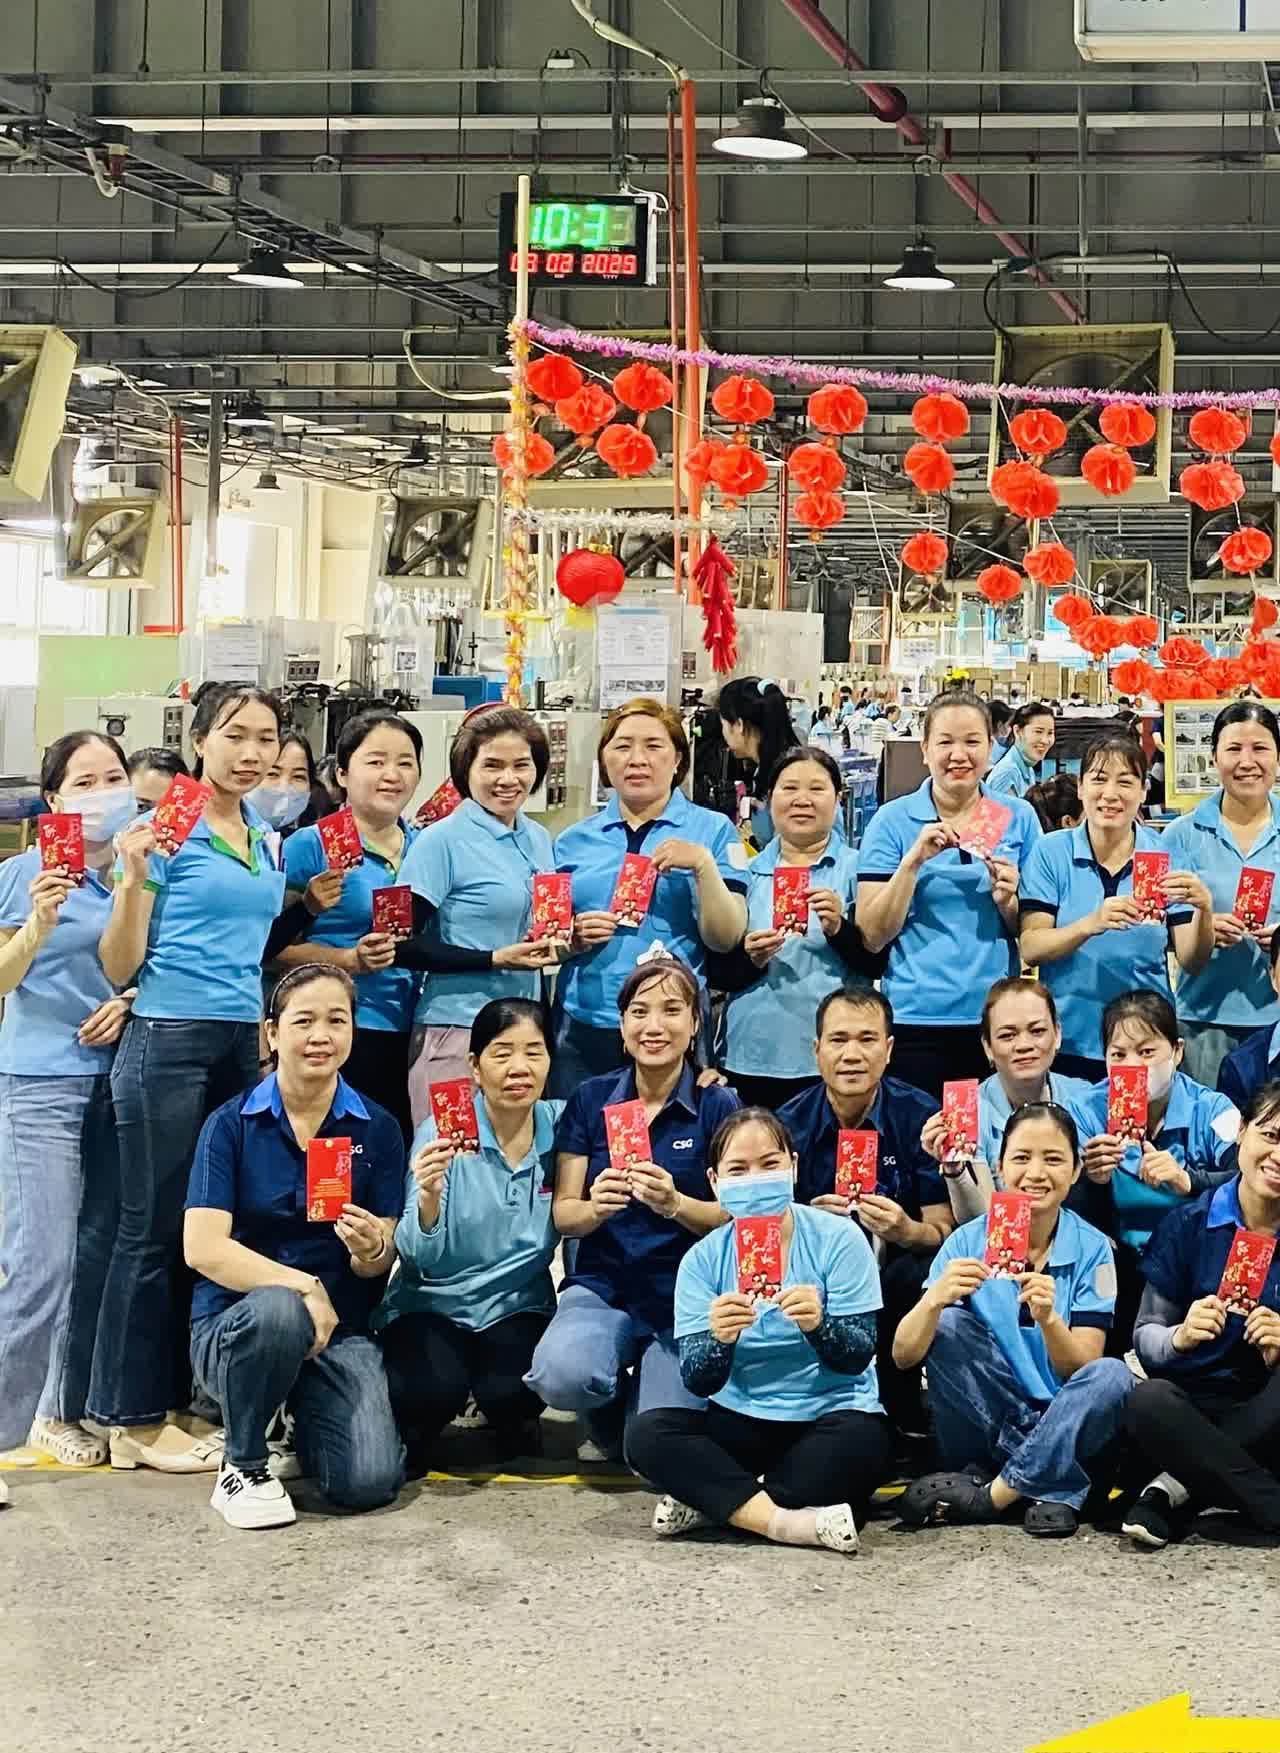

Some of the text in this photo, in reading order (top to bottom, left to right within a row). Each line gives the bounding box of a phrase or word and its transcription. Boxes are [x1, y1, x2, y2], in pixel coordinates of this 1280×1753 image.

[350, 1144, 364, 1155] SG
[672, 1138, 694, 1150] CSG
[882, 1155, 897, 1166] SG
